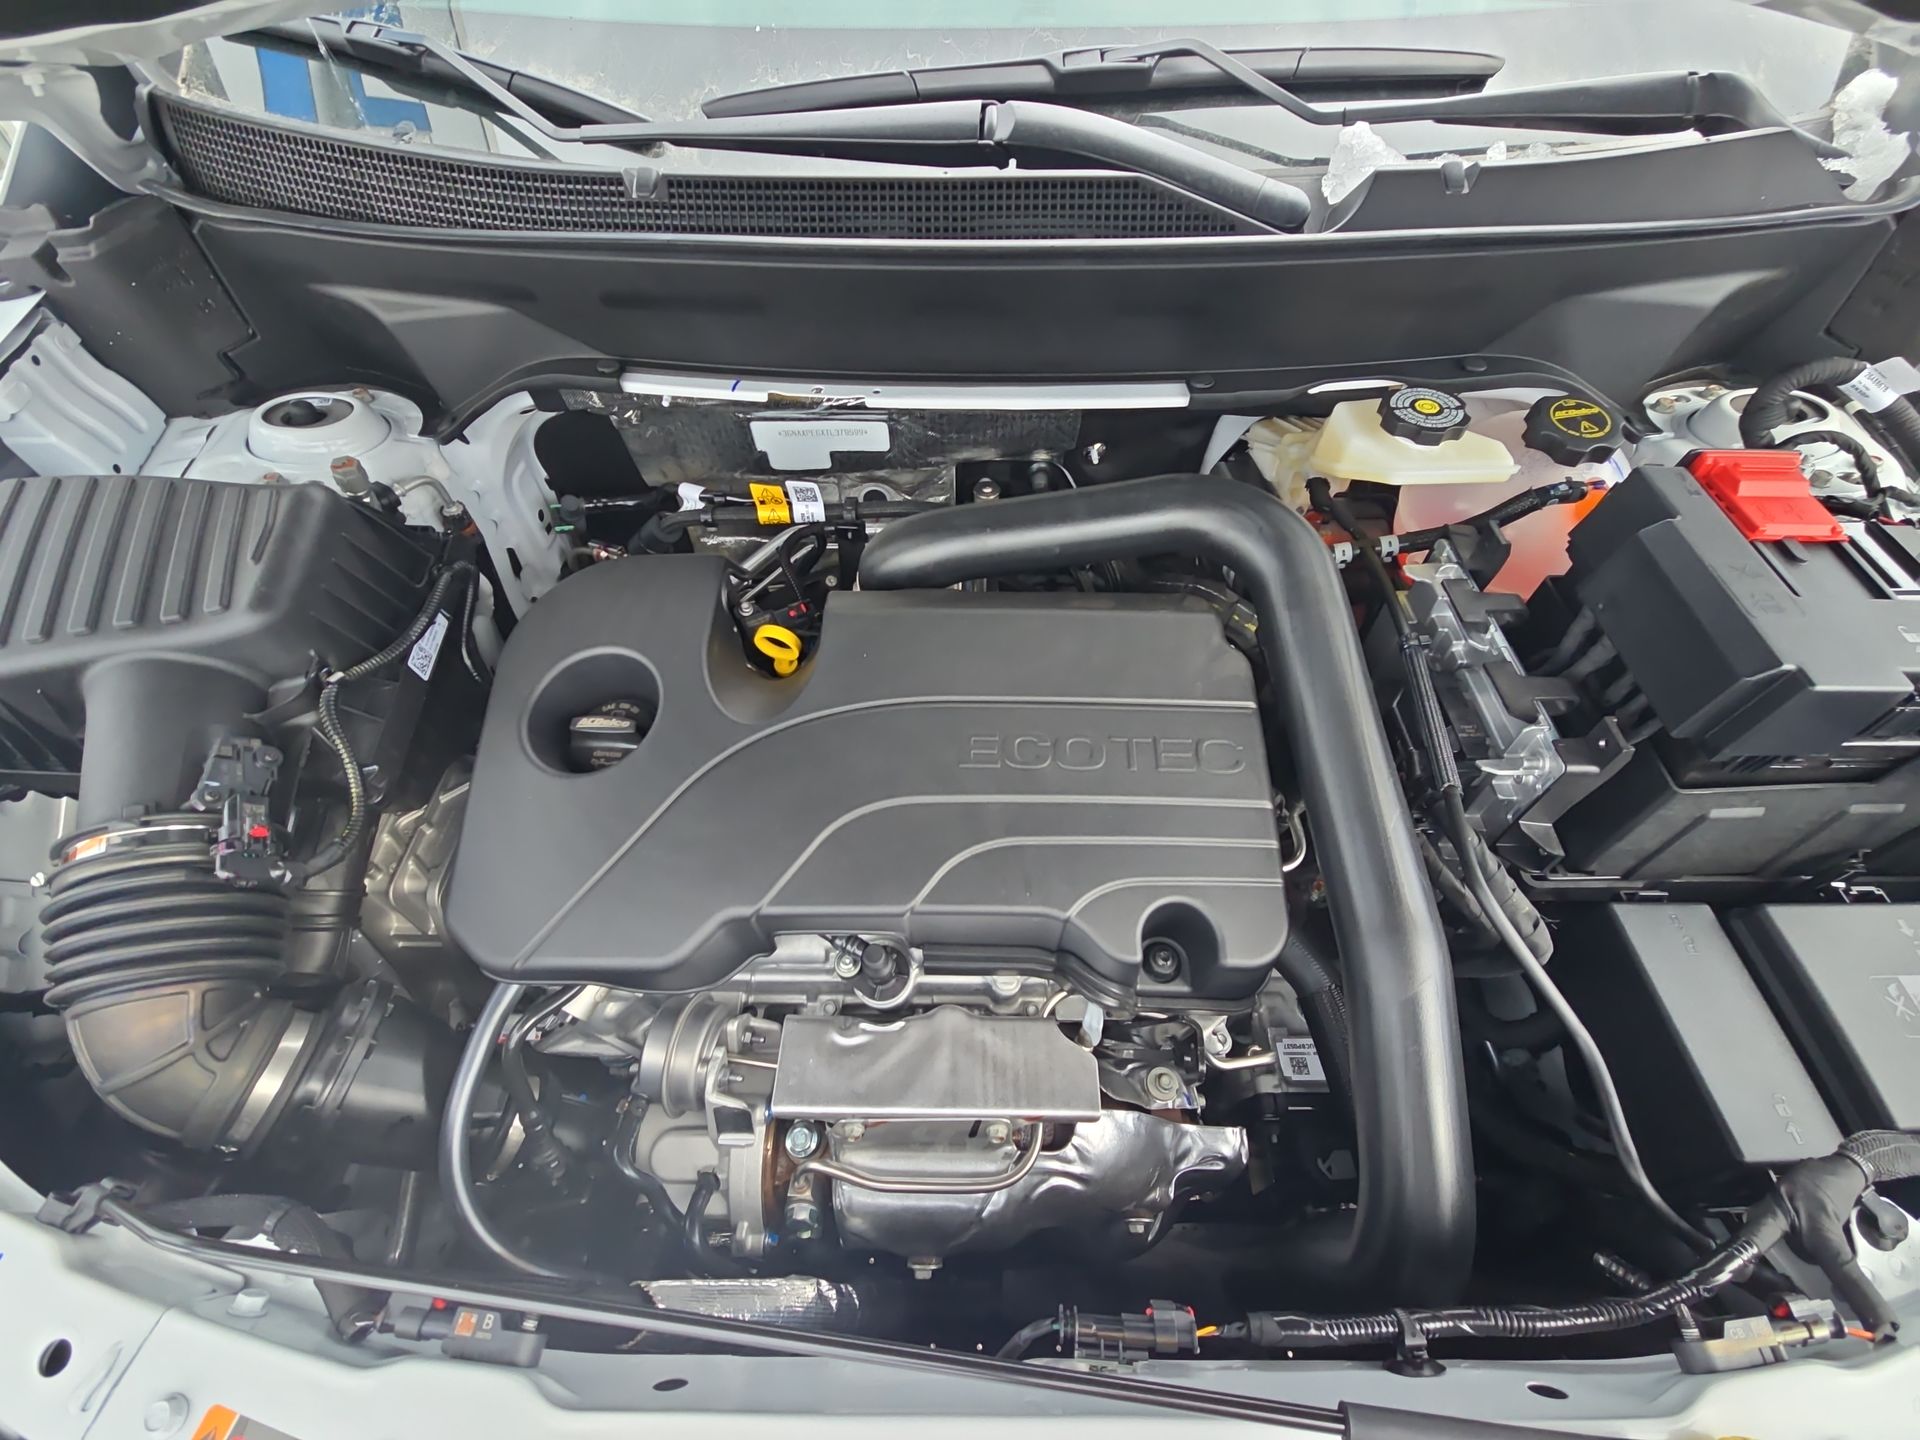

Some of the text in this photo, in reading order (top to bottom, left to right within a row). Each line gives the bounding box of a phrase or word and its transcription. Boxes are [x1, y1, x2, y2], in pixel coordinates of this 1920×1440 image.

[1554, 406, 1601, 420] ACDelco
[575, 717, 631, 729] ACDelco
[958, 731, 1246, 775] ECOTEC
[482, 1313, 495, 1330] B
